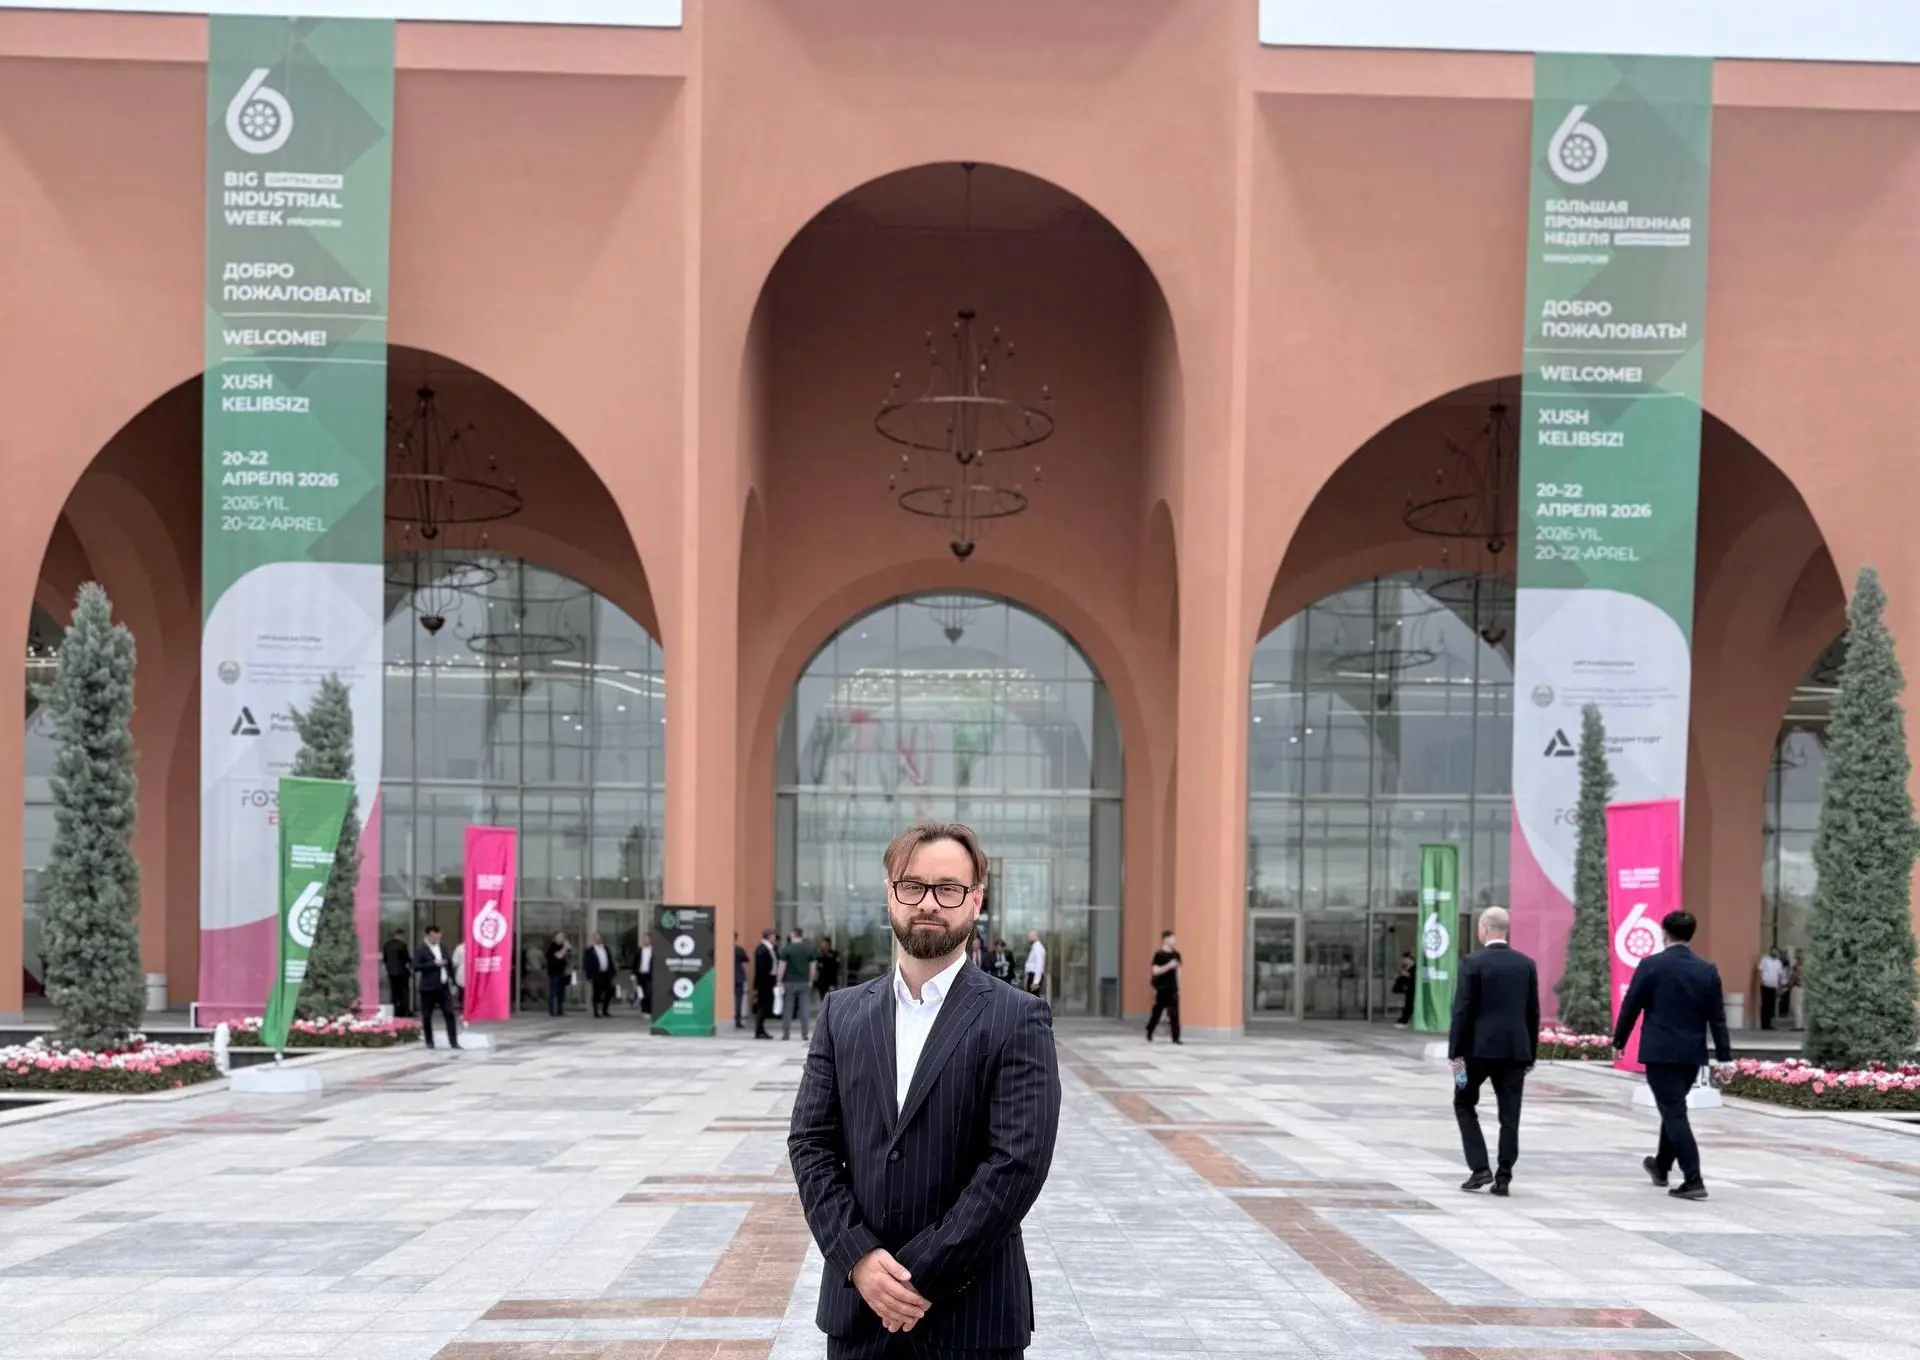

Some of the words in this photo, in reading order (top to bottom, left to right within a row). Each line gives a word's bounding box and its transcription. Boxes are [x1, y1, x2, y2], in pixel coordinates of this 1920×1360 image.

[224, 171, 258, 187] BIG
[224, 191, 342, 208] INDUSTRIAL
[1545, 200, 1629, 214] БОЛЬШАЯ
[225, 210, 283, 226] WEEK
[1544, 215, 1692, 231] ПРОМЫШЛЕННАЯ
[1544, 232, 1610, 247] НЕДЕЛЯ
[223, 263, 294, 280] ДОБРО
[223, 286, 371, 304] ПОЖАЛОВАТЬ!
[1542, 301, 1612, 317] ДОБРО
[223, 329, 327, 346] WELCOME!
[1542, 322, 1687, 339] ПОЖАЛОВАТЬ!
[221, 374, 273, 390] XUSH
[1540, 366, 1643, 383] WELCOME!
[222, 397, 310, 413] KELIBSIZ!
[1538, 409, 1590, 425] XUSH
[1538, 430, 1624, 447] KELIBSIZ!
[222, 451, 269, 466] 20-22
[222, 471, 294, 487] АПРЕЛЯ
[297, 473, 339, 487] 2026
[1536, 484, 1583, 498] 20-22
[221, 496, 290, 511] 2026-YIL
[1536, 503, 1607, 517] АПРЕЛЯ
[1610, 504, 1653, 518] 2026
[221, 516, 328, 532] 20-22-APREL
[1535, 526, 1603, 541] 2026-YIL
[1534, 546, 1640, 562] 20-22-APREL
